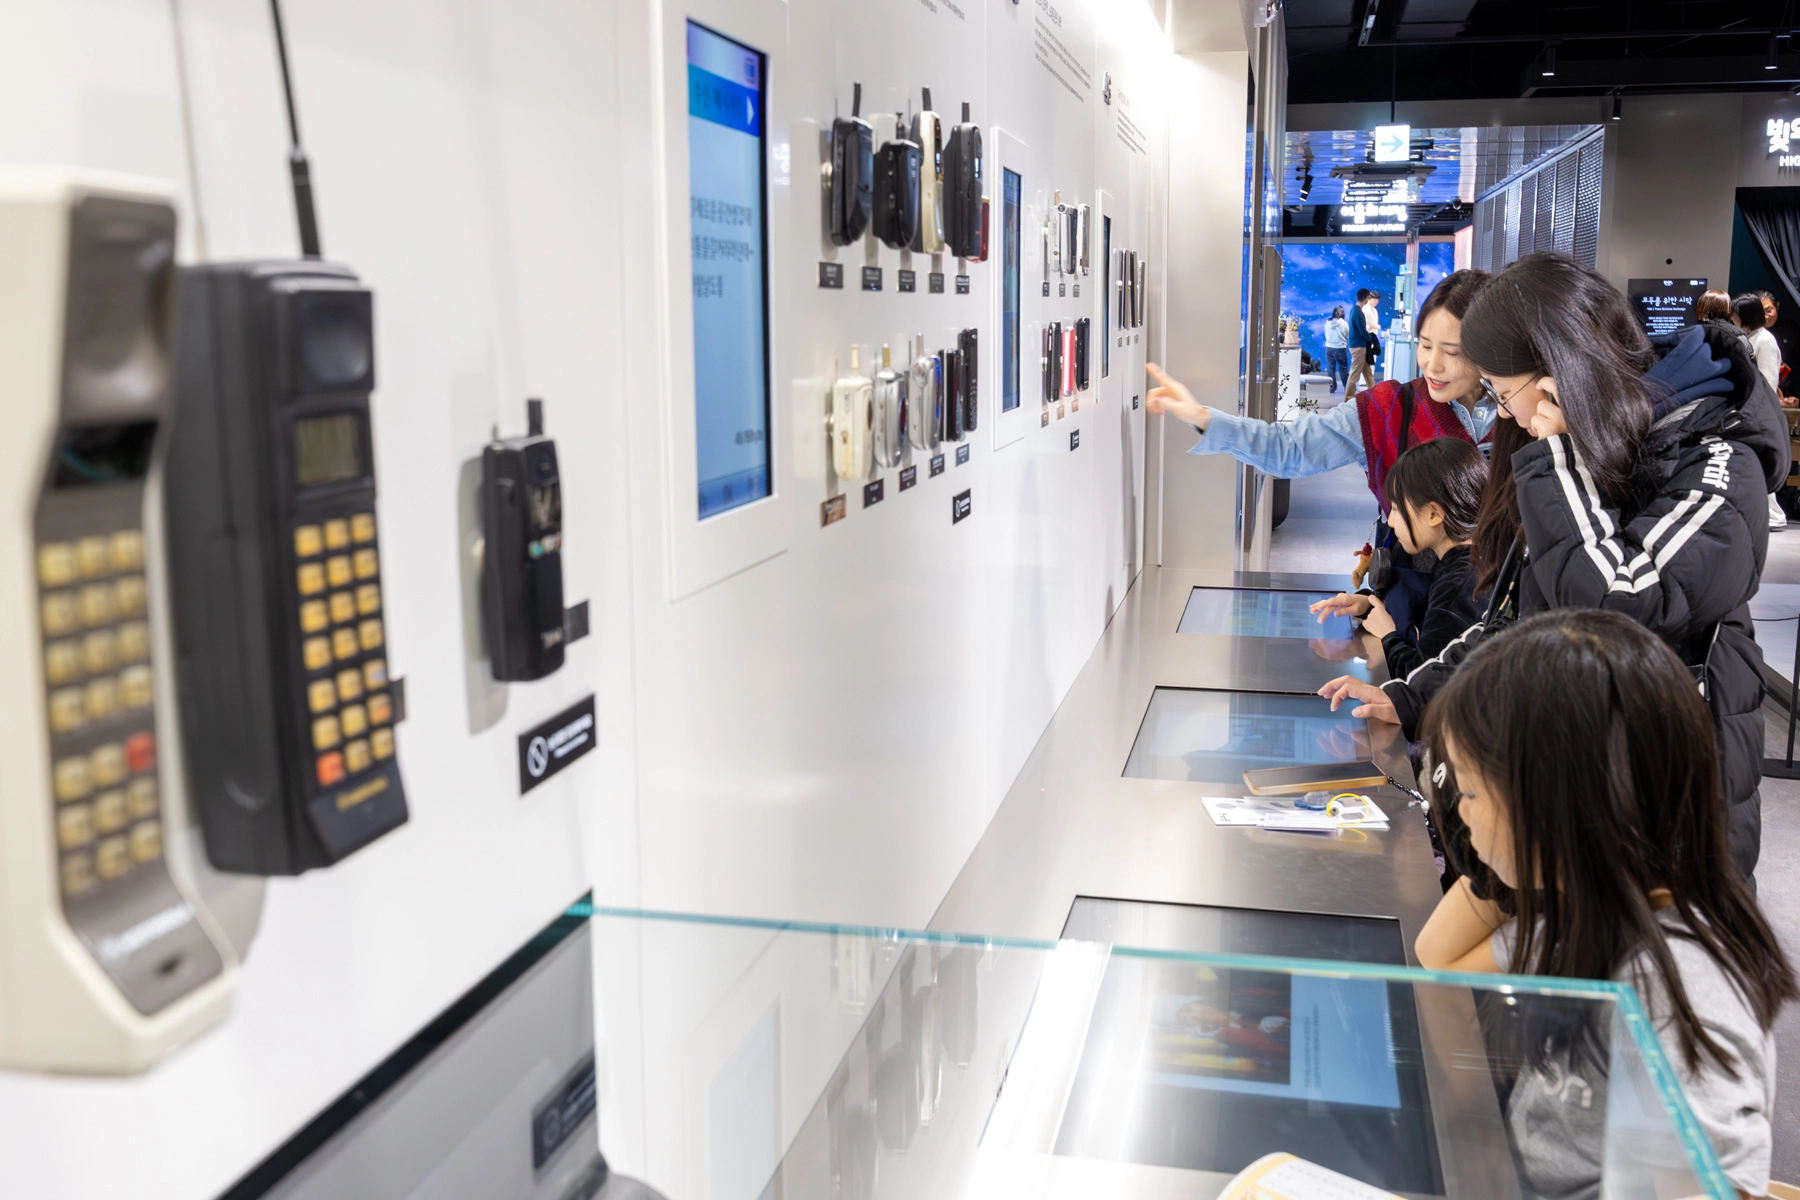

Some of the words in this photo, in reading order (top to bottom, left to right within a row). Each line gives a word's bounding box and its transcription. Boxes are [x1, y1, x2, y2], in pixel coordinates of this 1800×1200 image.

[1641, 296, 1661, 307] 모두를
[1663, 296, 1678, 306] 위한
[1679, 296, 1693, 306] 시작
